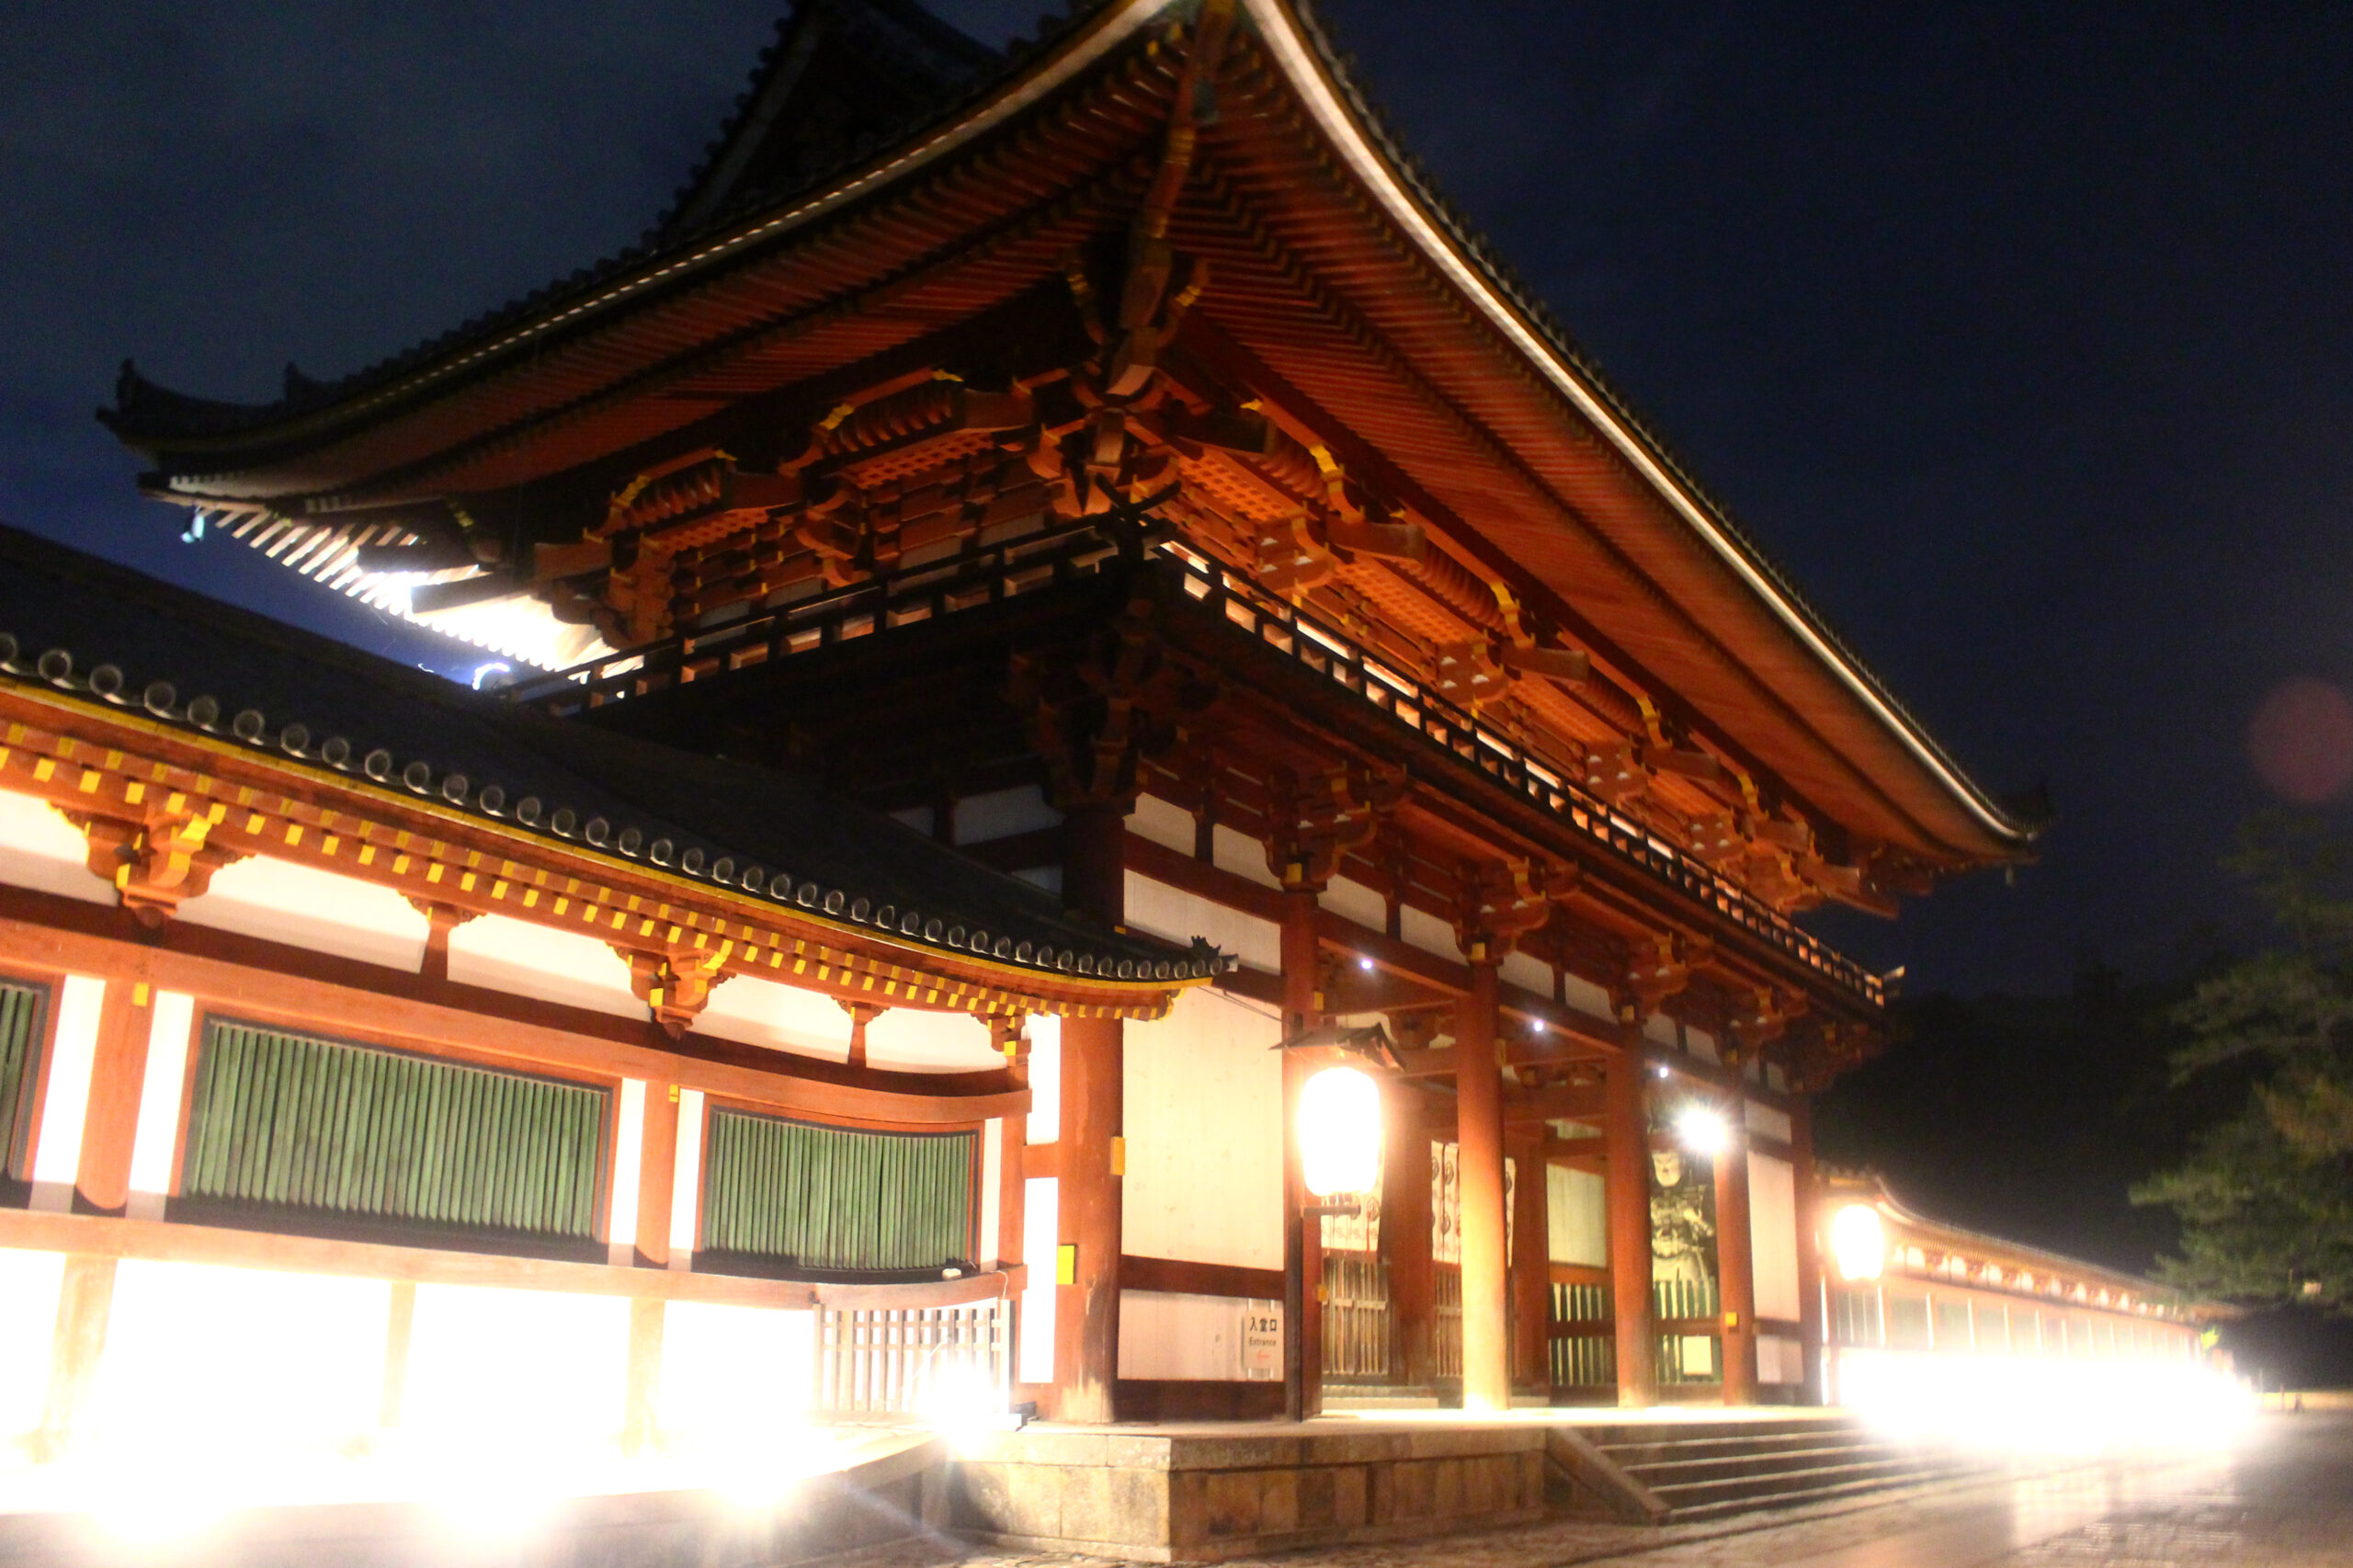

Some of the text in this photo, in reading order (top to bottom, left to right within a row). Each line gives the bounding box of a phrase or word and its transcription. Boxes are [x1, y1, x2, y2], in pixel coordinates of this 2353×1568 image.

[1249, 1316, 1278, 1332] 入堂口
[1249, 1336, 1277, 1346] Entrance
